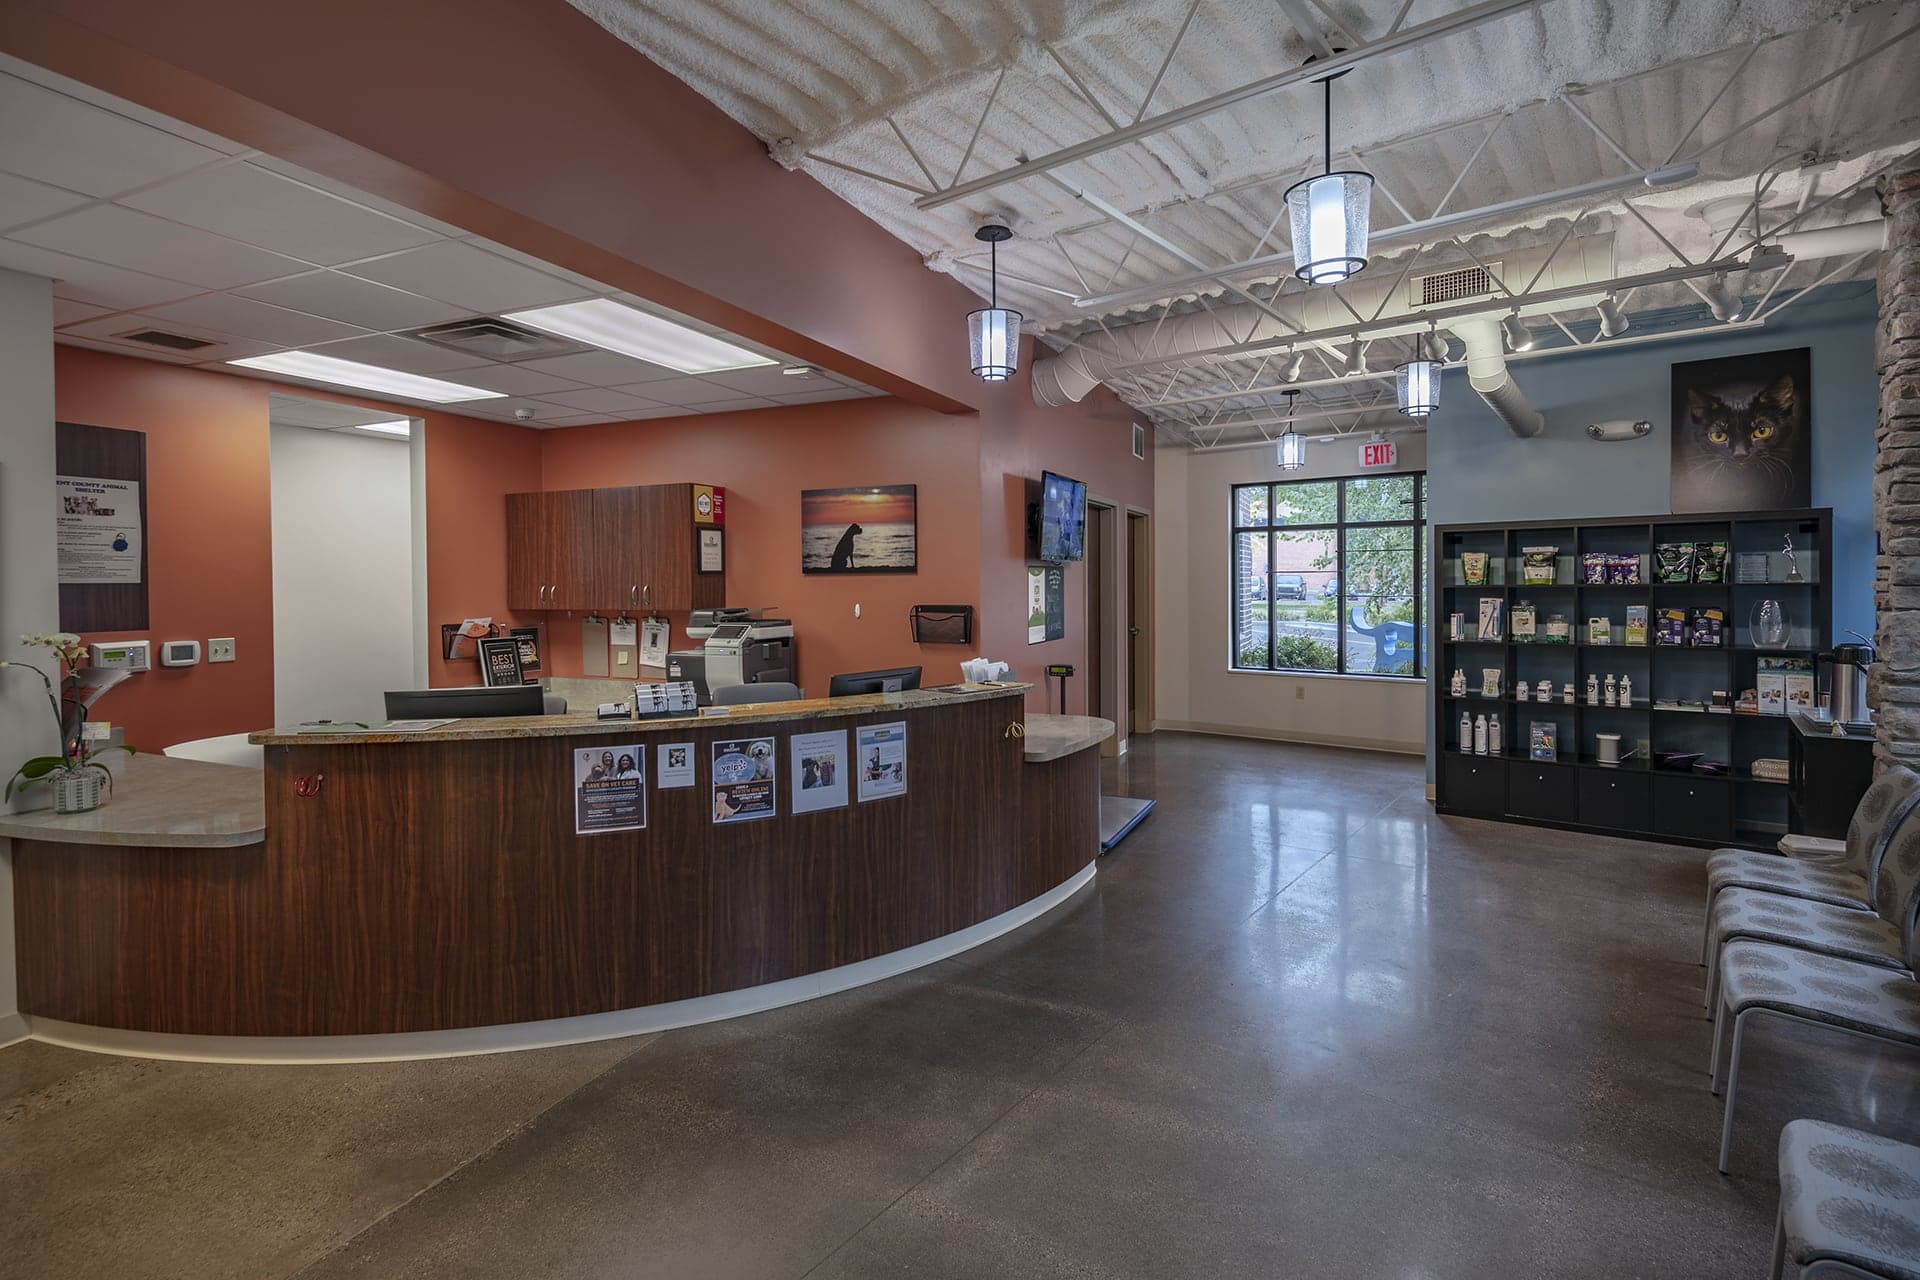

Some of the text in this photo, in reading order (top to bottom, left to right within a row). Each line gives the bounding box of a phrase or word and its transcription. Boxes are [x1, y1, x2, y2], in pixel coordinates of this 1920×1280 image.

[1365, 444, 1391, 465] EXIT
[491, 654, 513, 666] BEST
[721, 764, 739, 773] yelp
